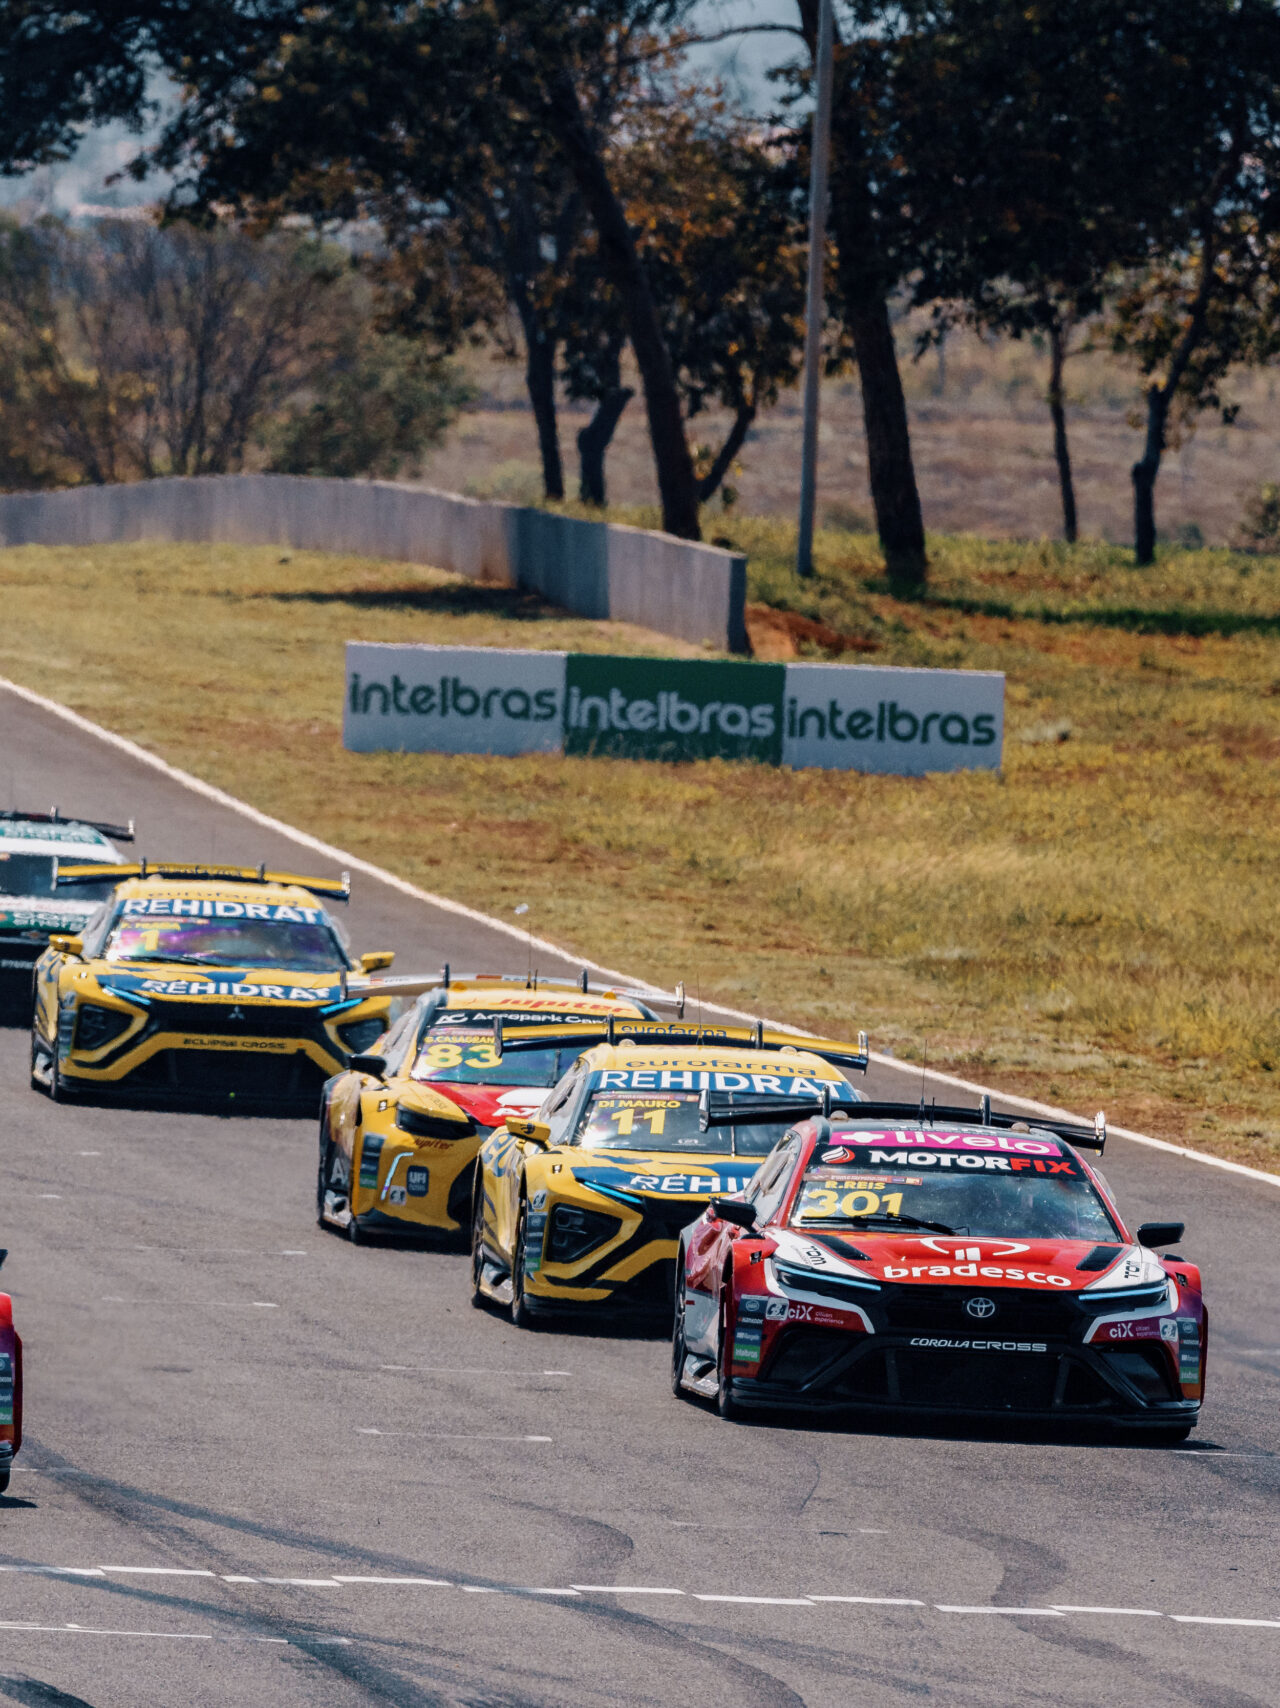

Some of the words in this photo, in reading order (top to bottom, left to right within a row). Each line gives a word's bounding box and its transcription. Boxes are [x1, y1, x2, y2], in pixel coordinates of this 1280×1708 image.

[348, 673, 557, 722] intelbras
[568, 687, 776, 738] intelbras
[787, 698, 997, 746] intelbras
[123, 898, 318, 924] REHIDRAT
[140, 929, 160, 951] 1
[183, 1038, 237, 1047] ECLIPSE
[621, 1023, 727, 1038] eurofarma
[424, 1044, 503, 1069] 83
[625, 1059, 817, 1077] eurofarma
[599, 1070, 843, 1099] REHIDRAT
[598, 1100, 617, 1108] DI
[618, 1100, 681, 1109] MAURO
[611, 1108, 666, 1136] 11
[894, 1130, 1051, 1155] livelo
[868, 1150, 1078, 1176] MOTORFIX
[824, 1180, 887, 1191] R.REIS
[802, 1189, 904, 1218] 301
[883, 1263, 1072, 1287] bradesco
[910, 1337, 970, 1348] COROLLA
[972, 1340, 1048, 1352] CROSS
